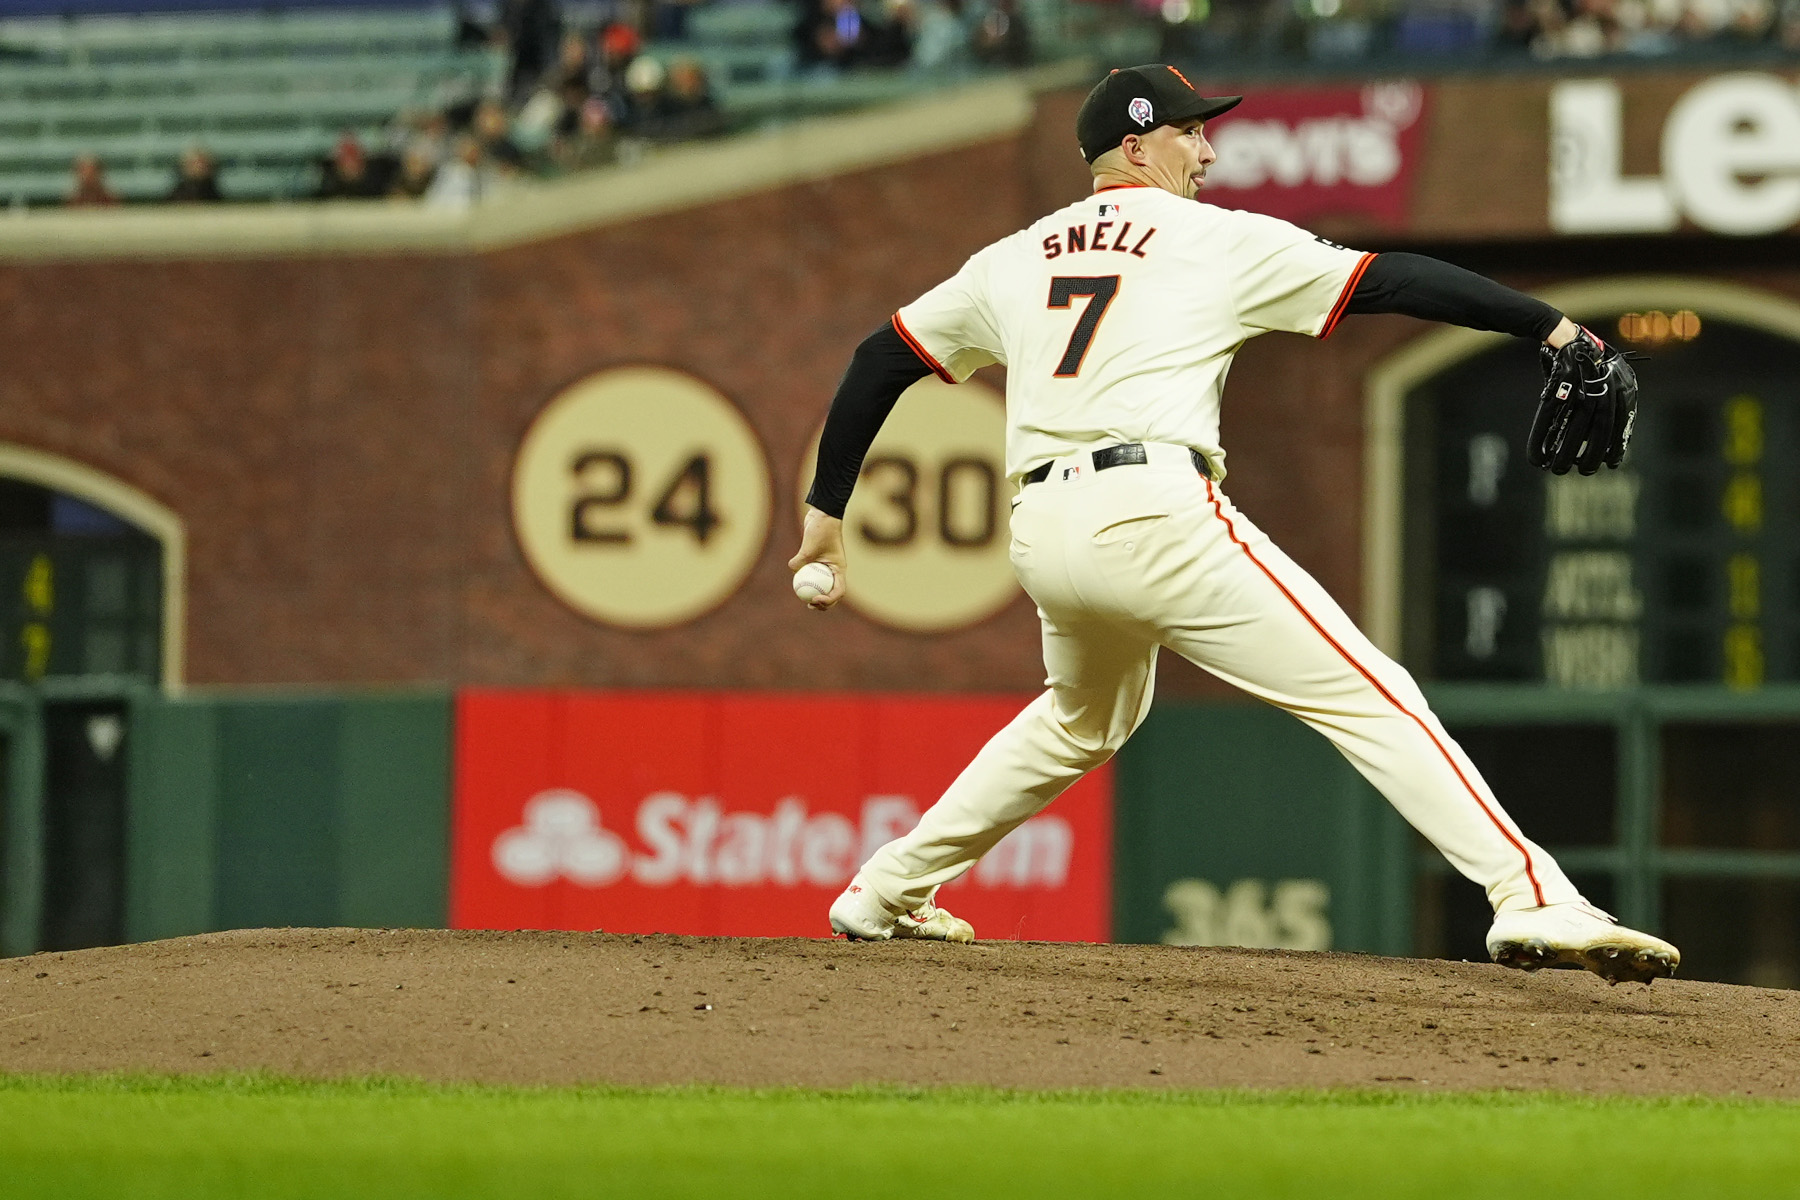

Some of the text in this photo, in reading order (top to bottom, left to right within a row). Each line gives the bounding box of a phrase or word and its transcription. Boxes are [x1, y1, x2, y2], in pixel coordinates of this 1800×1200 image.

[1042, 221, 1157, 260] SNELL
[1047, 274, 1122, 378] 7
[564, 446, 727, 551] 24
[857, 452, 998, 553] 30
[1164, 878, 1332, 949] 365
